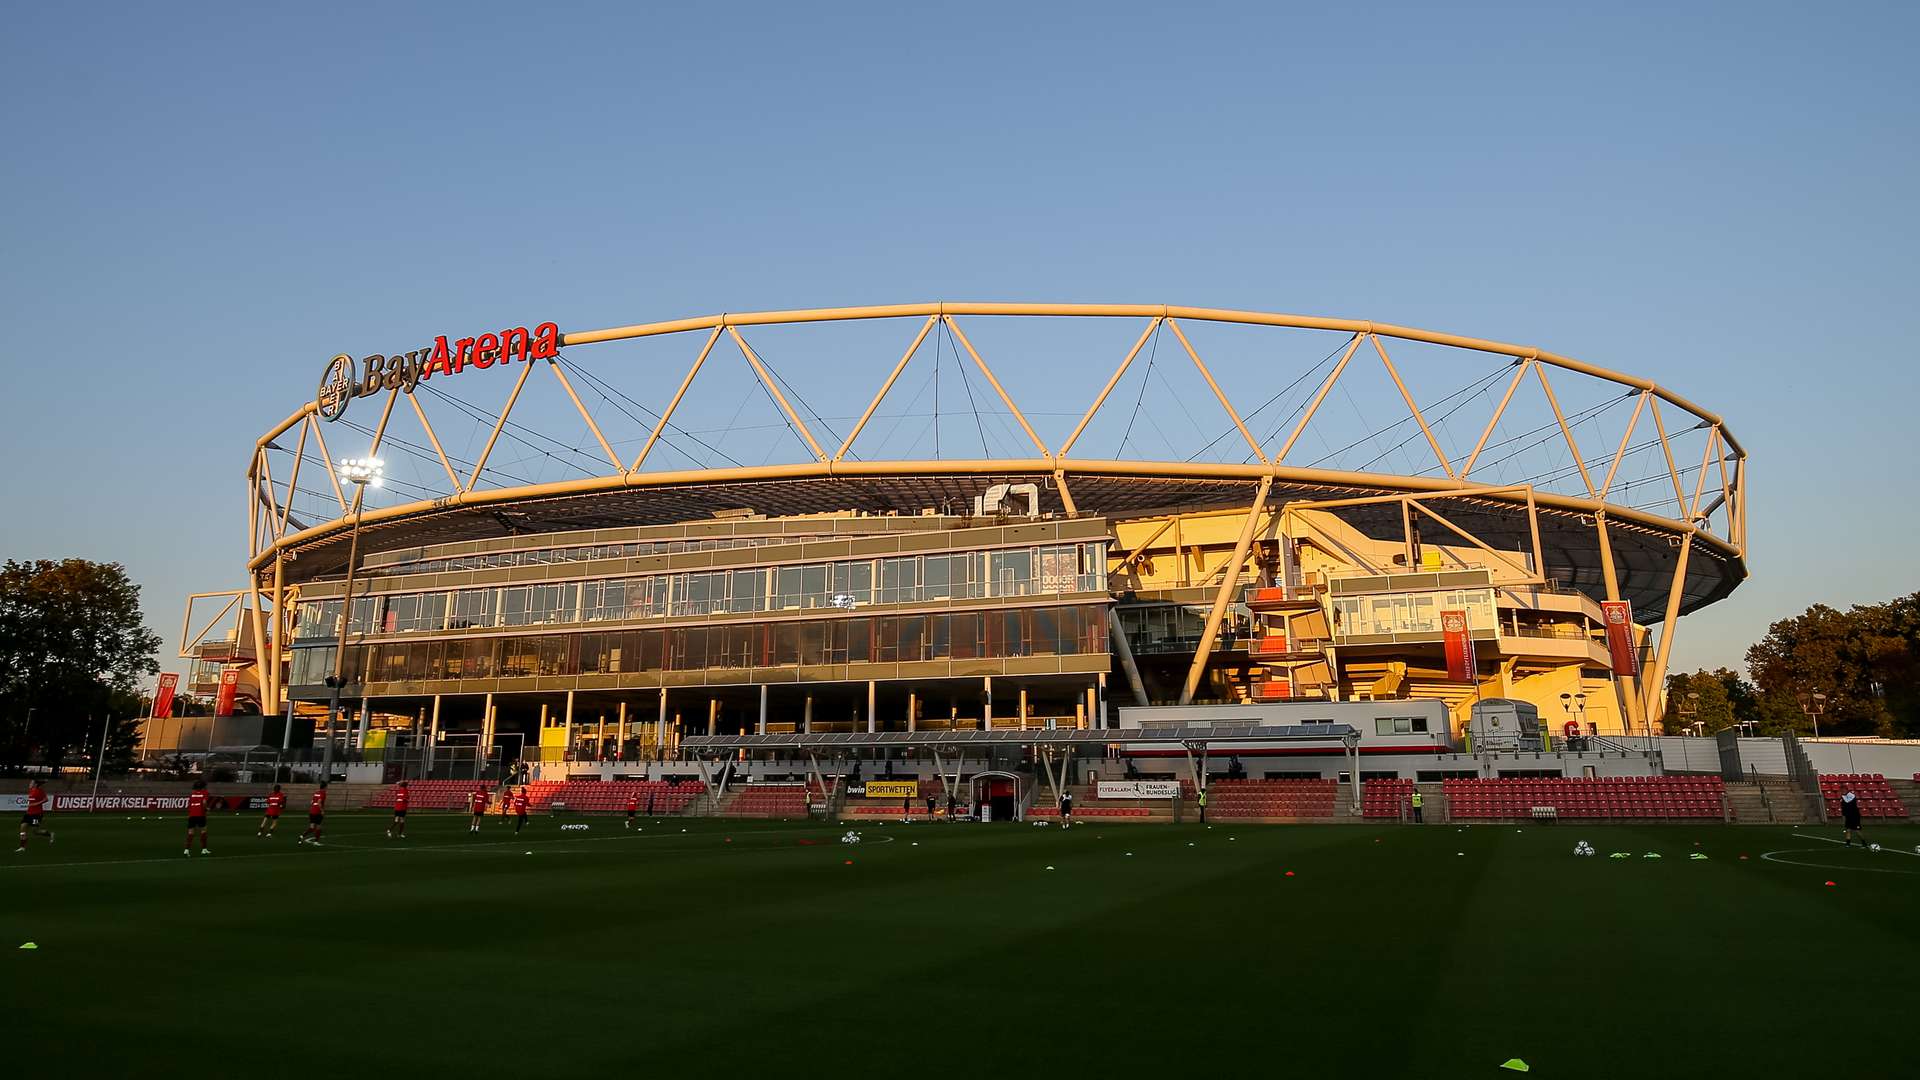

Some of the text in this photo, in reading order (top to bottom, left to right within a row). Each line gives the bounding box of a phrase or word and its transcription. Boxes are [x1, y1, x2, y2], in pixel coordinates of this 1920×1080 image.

[358, 321, 560, 398] BayArena
[320, 377, 349, 397] BAYER
[847, 785, 865, 794] bwin
[868, 785, 916, 794] SPORTWETTEN
[56, 797, 93, 809] UNSER
